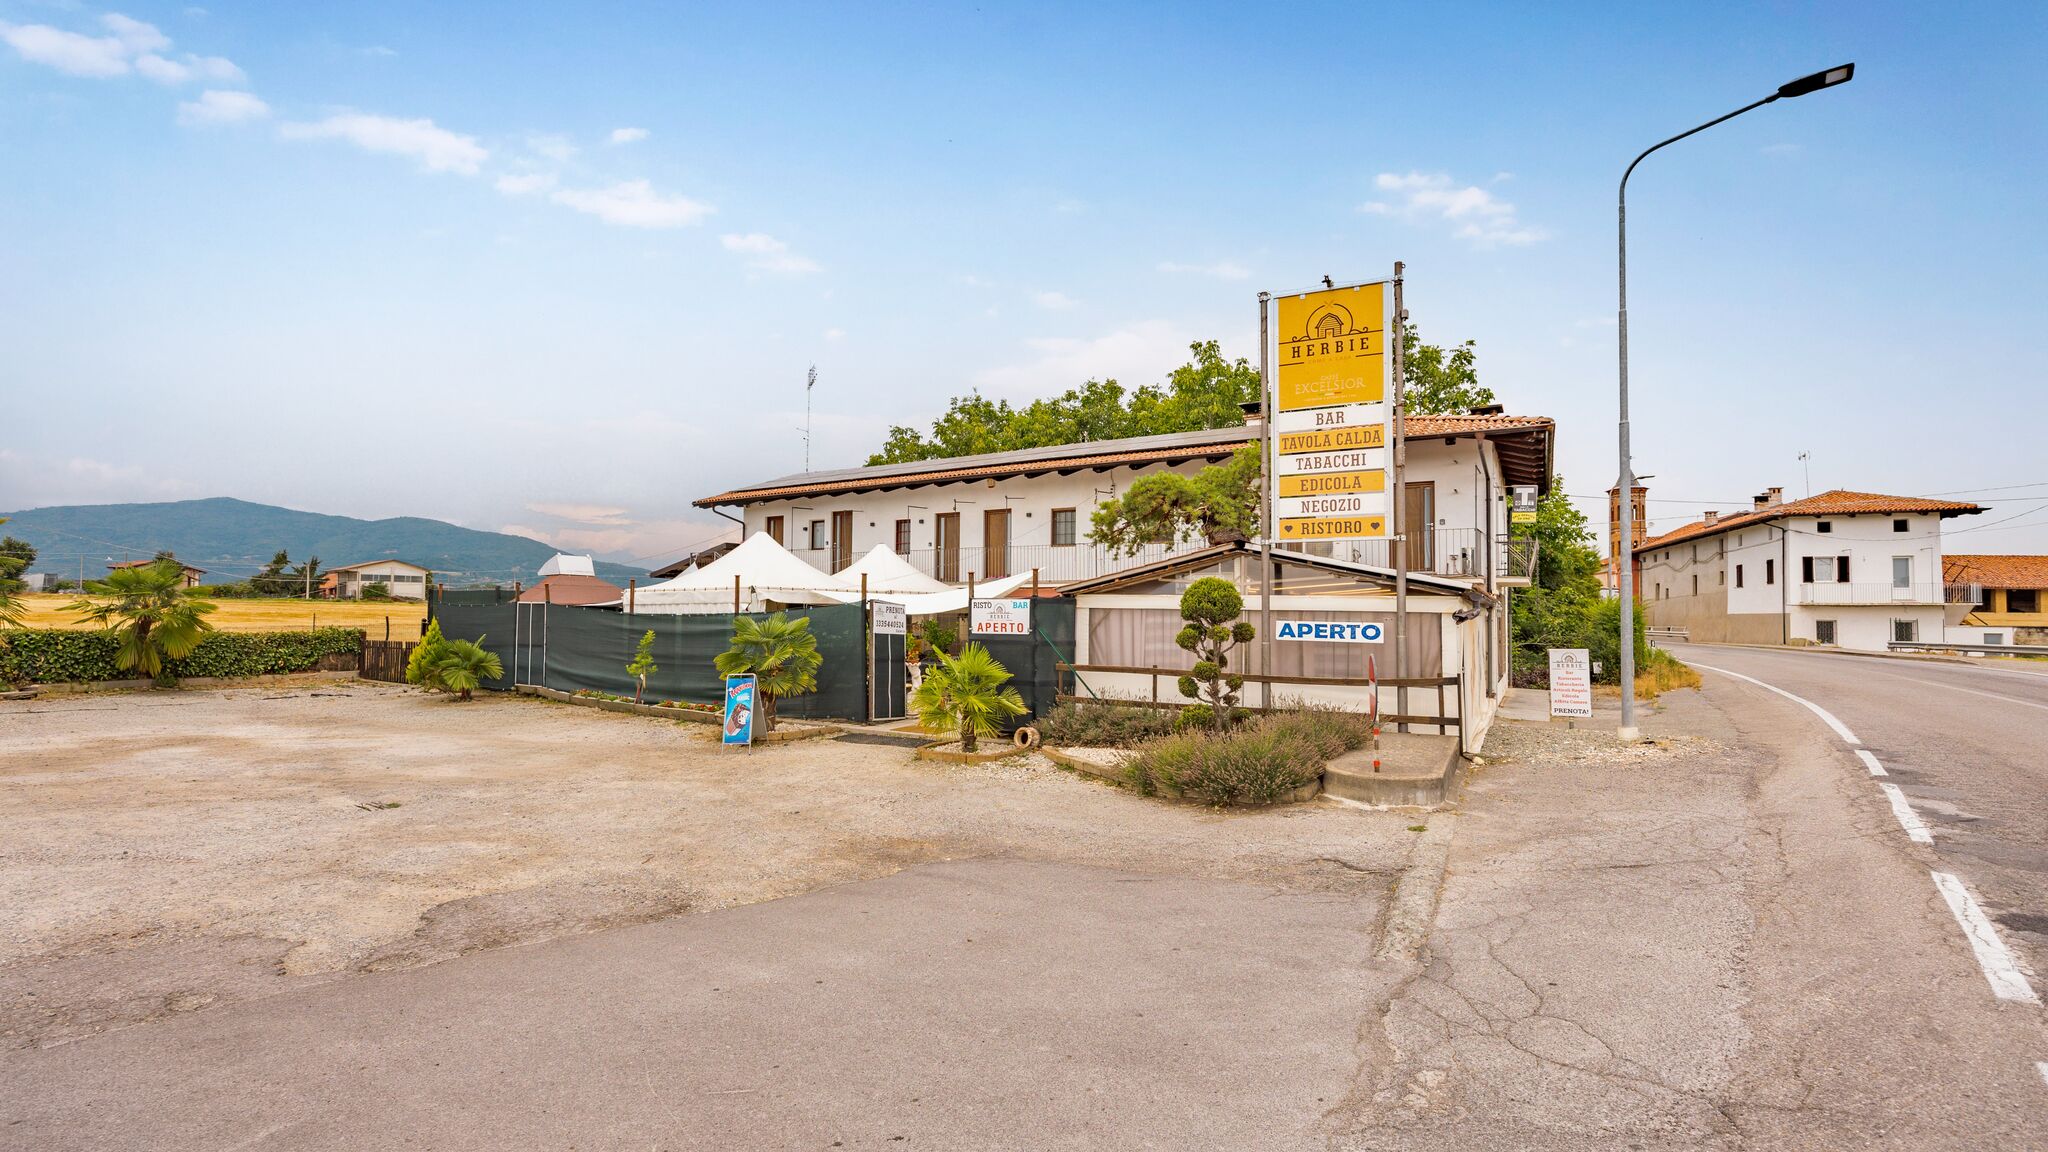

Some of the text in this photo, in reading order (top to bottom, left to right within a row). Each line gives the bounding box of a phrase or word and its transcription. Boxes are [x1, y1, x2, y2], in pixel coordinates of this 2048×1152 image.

[1292, 337, 1369, 358] HERBIE
[1295, 377, 1367, 395] EXCELSIOR
[1315, 411, 1345, 426] BAR
[1281, 429, 1382, 450] TAVOLA CALDA
[1295, 453, 1367, 470] TABACCHI
[1300, 476, 1362, 492] EDICOLA
[1515, 487, 1535, 506] T
[1300, 498, 1361, 513] NEGOZIO
[1300, 520, 1362, 535] RISTORO
[1012, 601, 1029, 609] BAR
[977, 622, 1025, 633] APERTO
[1278, 623, 1381, 640] APERTO
